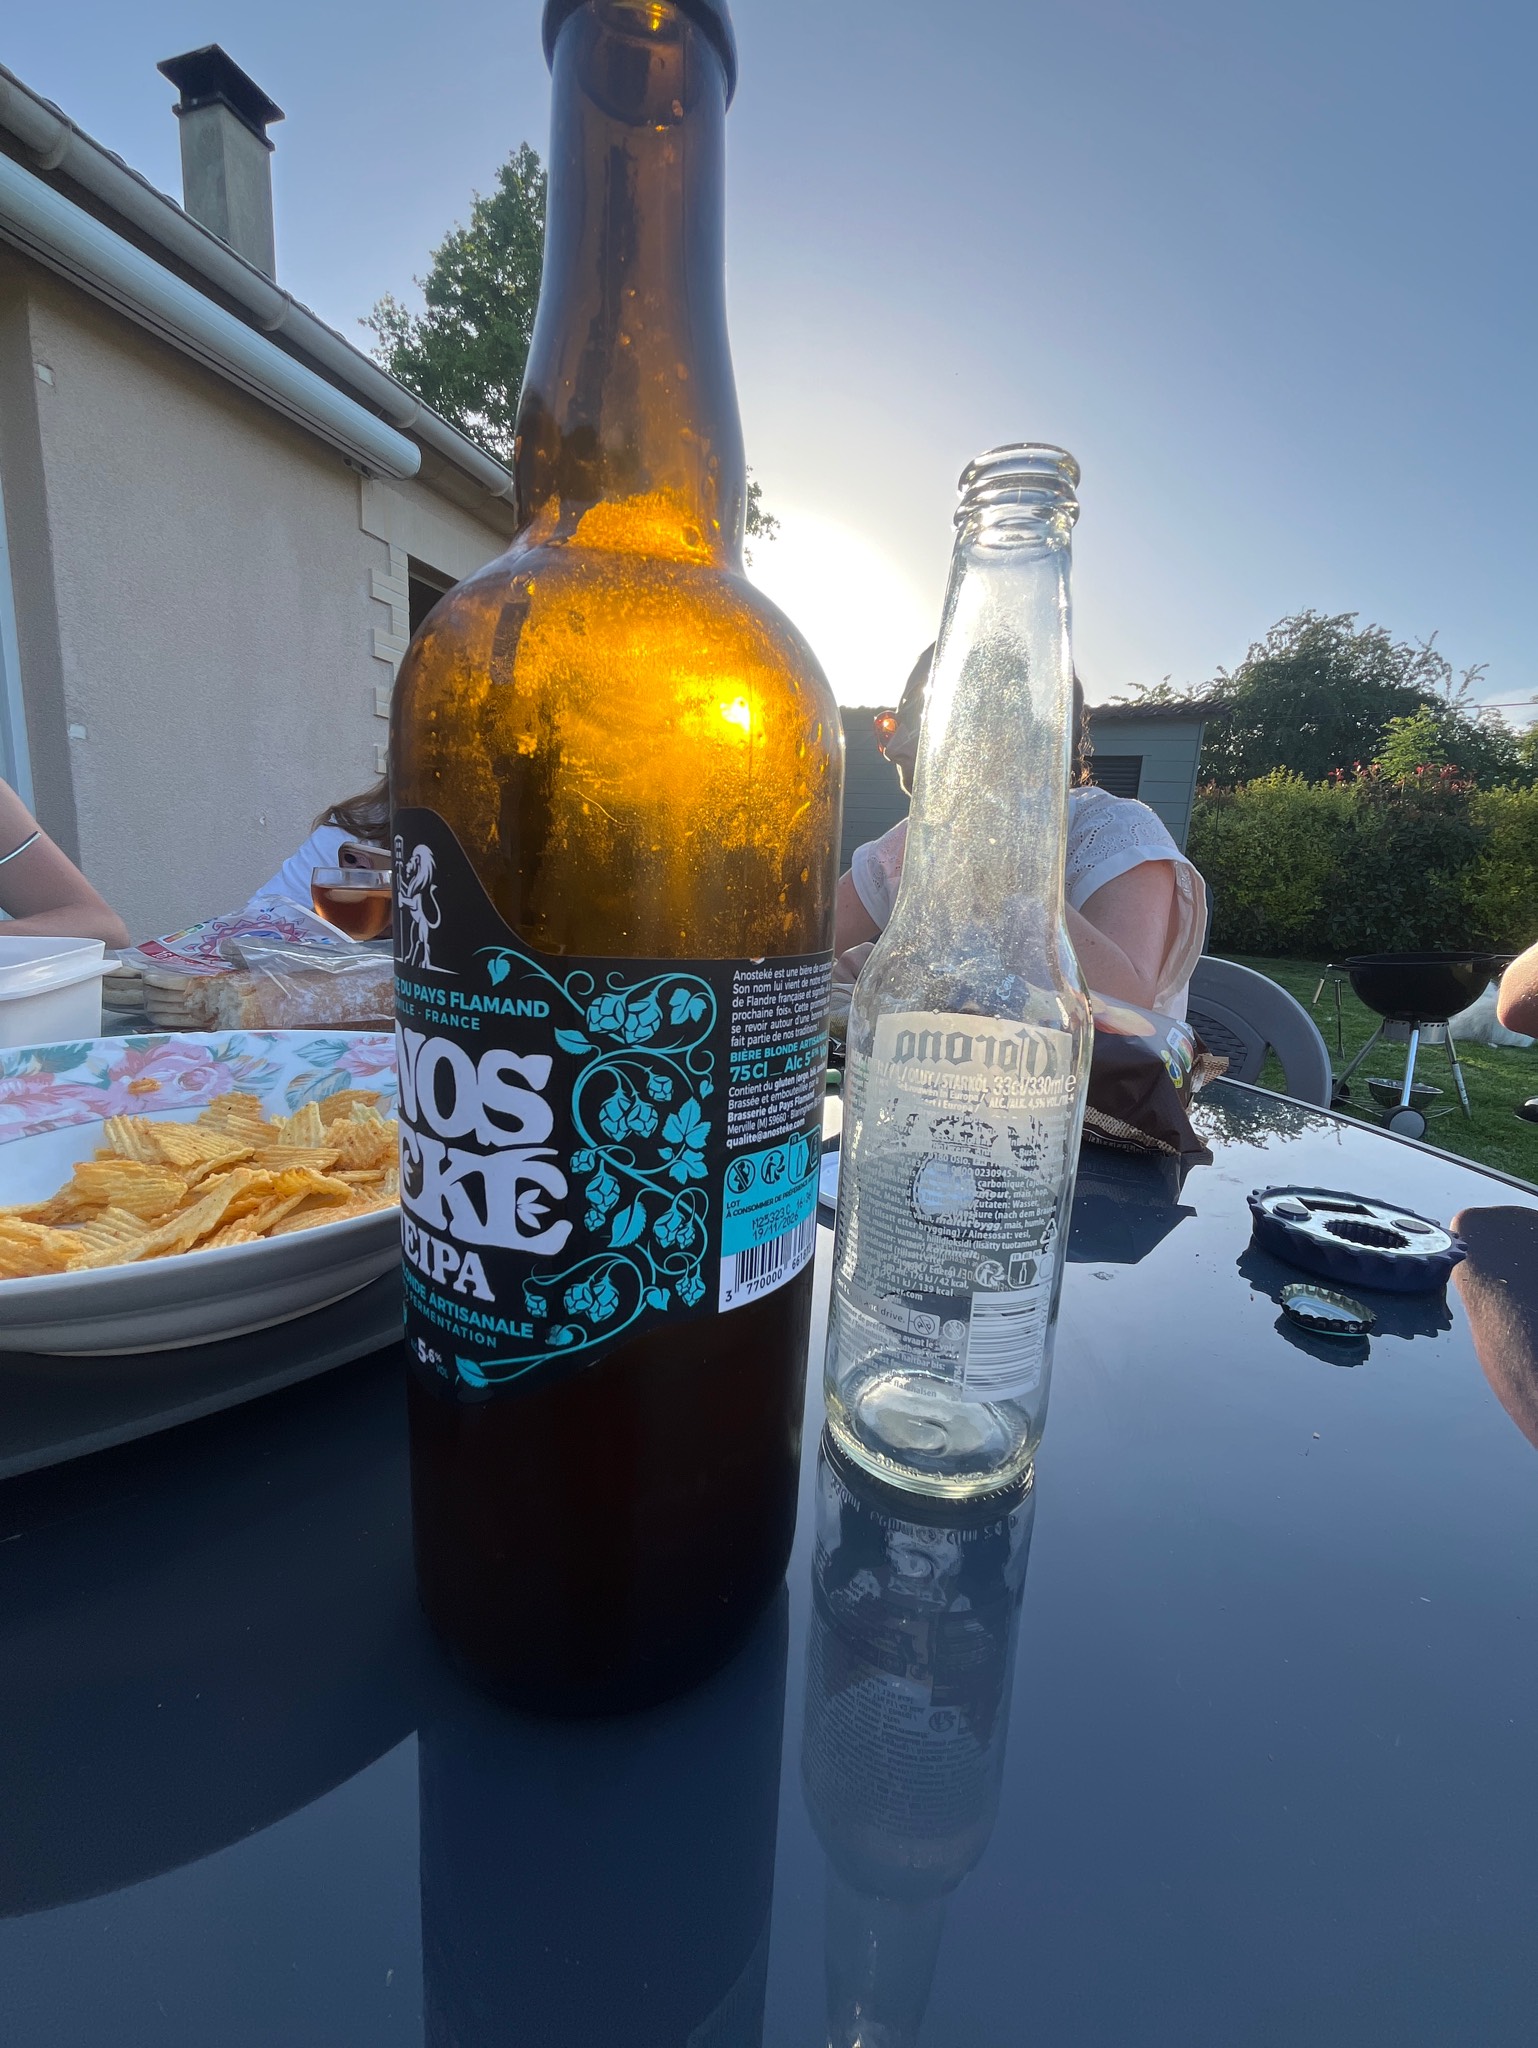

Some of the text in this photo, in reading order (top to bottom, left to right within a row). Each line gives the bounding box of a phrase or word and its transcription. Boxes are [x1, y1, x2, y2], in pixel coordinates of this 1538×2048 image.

[733, 967, 773, 981] Anosteké
[774, 969, 785, 979] est
[786, 968, 798, 977] une
[732, 983, 750, 994] Son
[753, 983, 771, 994] nom
[774, 980, 783, 991] lui
[785, 979, 800, 990] vient
[801, 977, 809, 987] de
[401, 981, 412, 996] DU
[414, 983, 446, 1006] PAYS
[450, 991, 550, 1018] FLAMAND
[732, 996, 744, 1008] de
[746, 994, 776, 1007] Flandre
[778, 990, 805, 1004] française
[425, 1008, 480, 1030] FRANCE
[731, 1007, 773, 1023] prochaine
[794, 1003, 809, 1013] Cette
[731, 1024, 741, 1034] se
[745, 1020, 768, 1032] revoir
[770, 1018, 793, 1030] autour
[731, 1035, 745, 1047] fait
[747, 1032, 771, 1048] partie
[772, 1031, 781, 1041] de
[783, 1030, 794, 1039] nos
[730, 1048, 762, 1063] BIÈRE
[764, 1042, 798, 1058] BLONDE
[784, 1056, 803, 1073] Alc
[729, 1083, 761, 1098] Contient
[763, 1080, 773, 1090] du
[774, 1076, 795, 1093] gluten
[728, 1096, 760, 1110] Brassée
[761, 1093, 769, 1104] et
[950, 1090, 979, 1103] Europa
[727, 1106, 766, 1122] Brasserie
[767, 1104, 778, 1115] du
[779, 1098, 794, 1112] Pays
[726, 1118, 806, 1150] qualite@anosteke.com
[727, 1119, 756, 1135] Merville
[978, 1179, 1025, 1190] carbonique
[726, 1200, 740, 1210] LOT
[733, 1197, 774, 1217] CONSOMMER
[774, 1194, 782, 1203] DE
[1019, 1210, 1035, 1218] dem
[752, 1210, 799, 1242] 19/11/2026
[918, 1221, 961, 1238] brygging)
[968, 1229, 1013, 1240] Ainesosat:
[725, 1268, 783, 1303] 3 770000
[918, 1282, 934, 1293] 139
[936, 1285, 954, 1297] kcal
[940, 1278, 949, 1287] 42
[951, 1278, 969, 1289] kcal,
[410, 1291, 497, 1349] FERMENTATION
[429, 1292, 534, 1339] ARTISANALE
[880, 1308, 906, 1323] drive.
